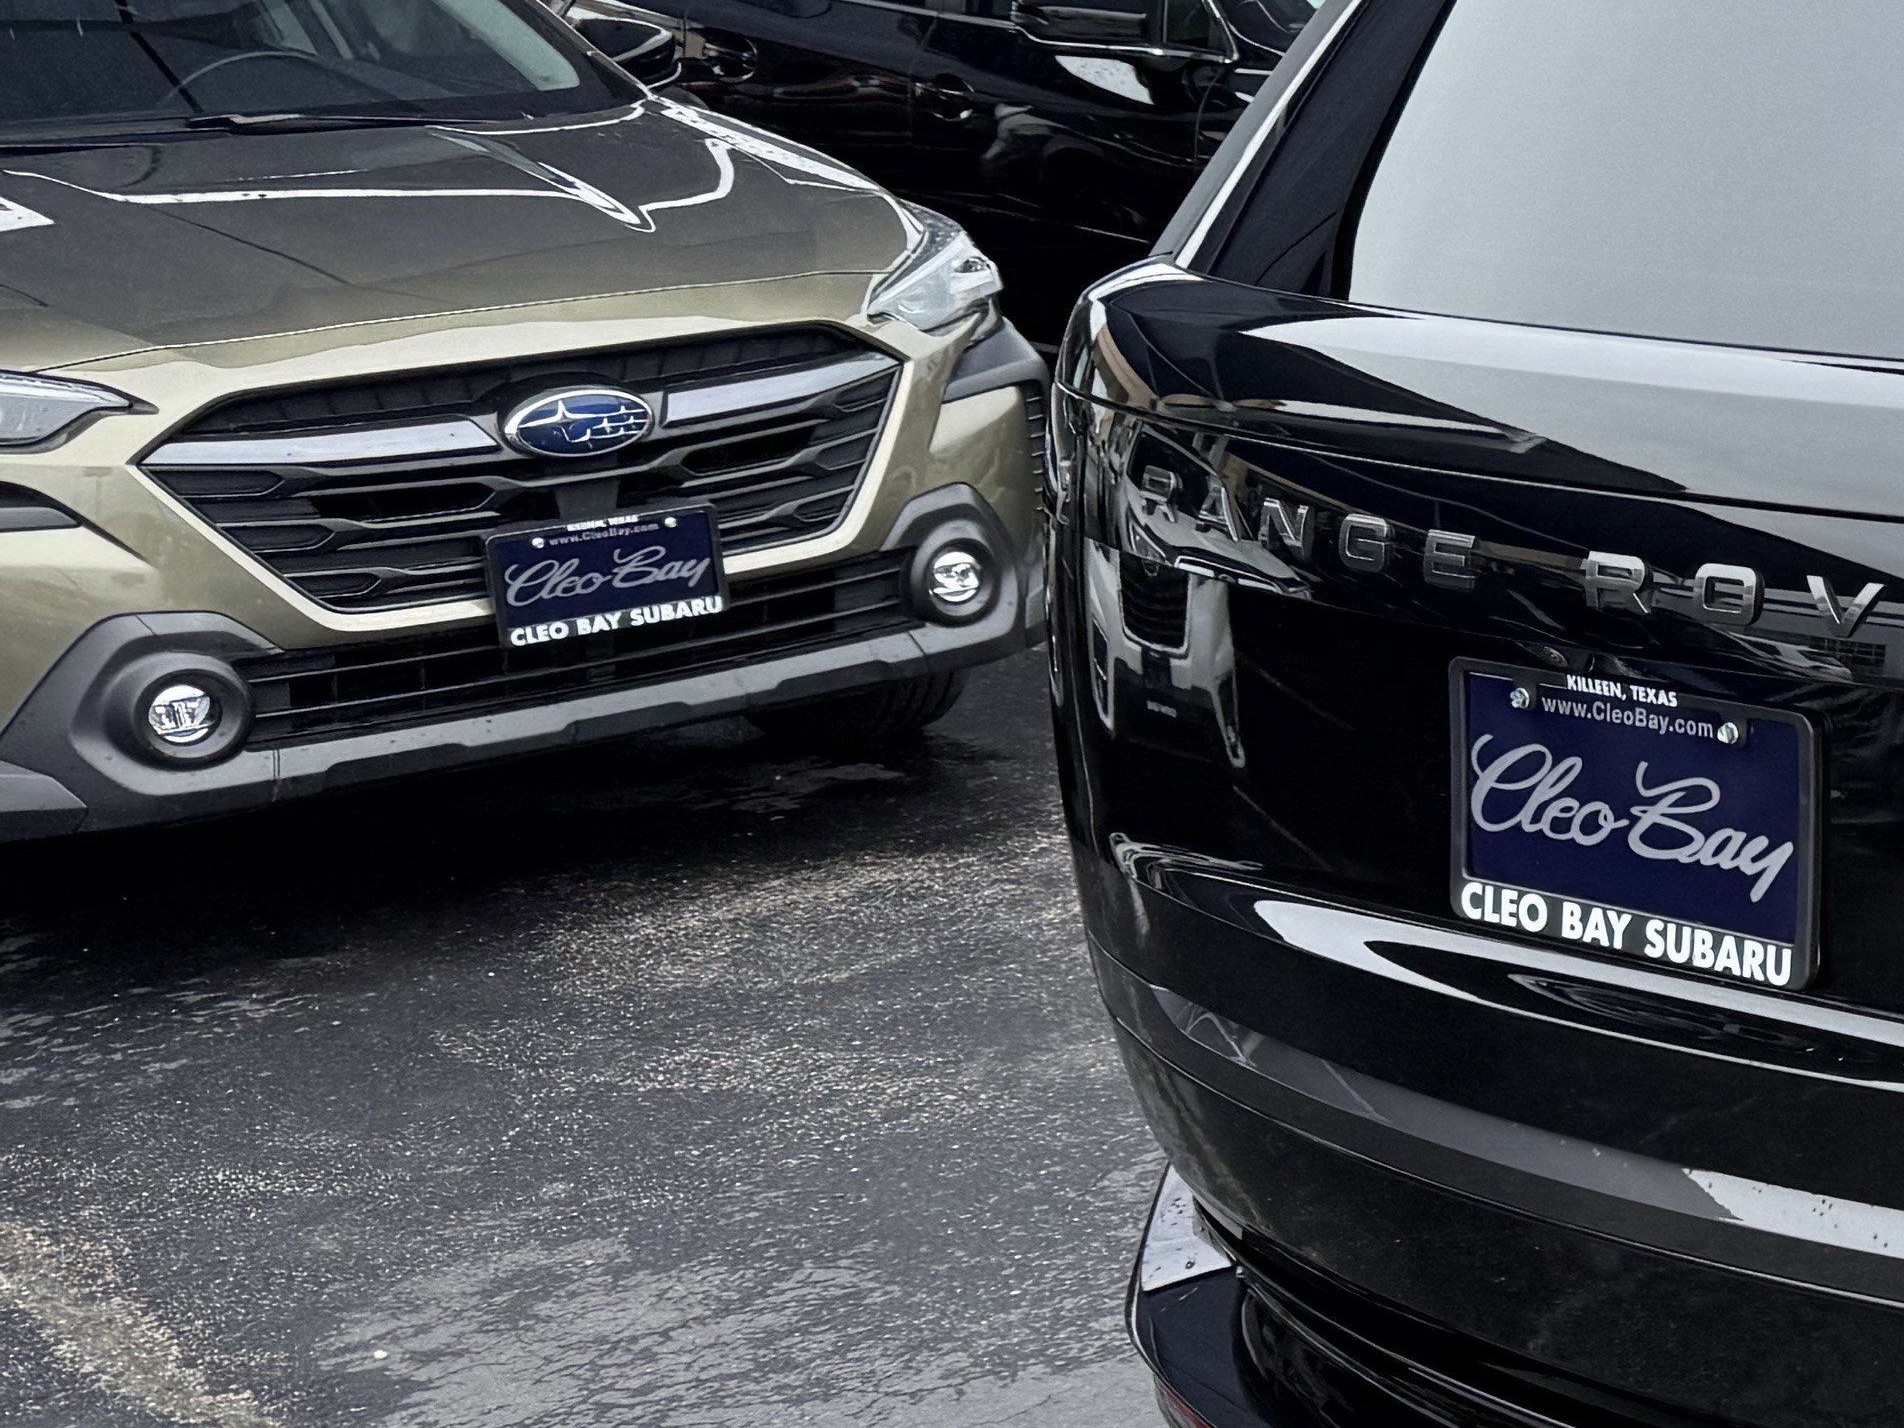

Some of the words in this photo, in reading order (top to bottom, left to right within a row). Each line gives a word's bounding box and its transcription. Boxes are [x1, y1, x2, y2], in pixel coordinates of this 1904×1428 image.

[1141, 465, 1480, 593] RANGE
[505, 558, 612, 608] Cleo
[612, 546, 711, 588] Bay
[510, 623, 570, 647] CLEO
[577, 610, 623, 636] BAY
[630, 595, 723, 627] SUBARU
[1541, 693, 1715, 739] www.CleoBay.com
[1565, 674, 1627, 702] KILLEEN,
[1630, 685, 1679, 708] TEXAS
[1470, 733, 1630, 847] Cleo
[1628, 760, 1795, 903] Bay
[1461, 882, 1548, 933] CLEO
[1561, 901, 1632, 950] BAY
[1644, 919, 1793, 986] SUBARU
